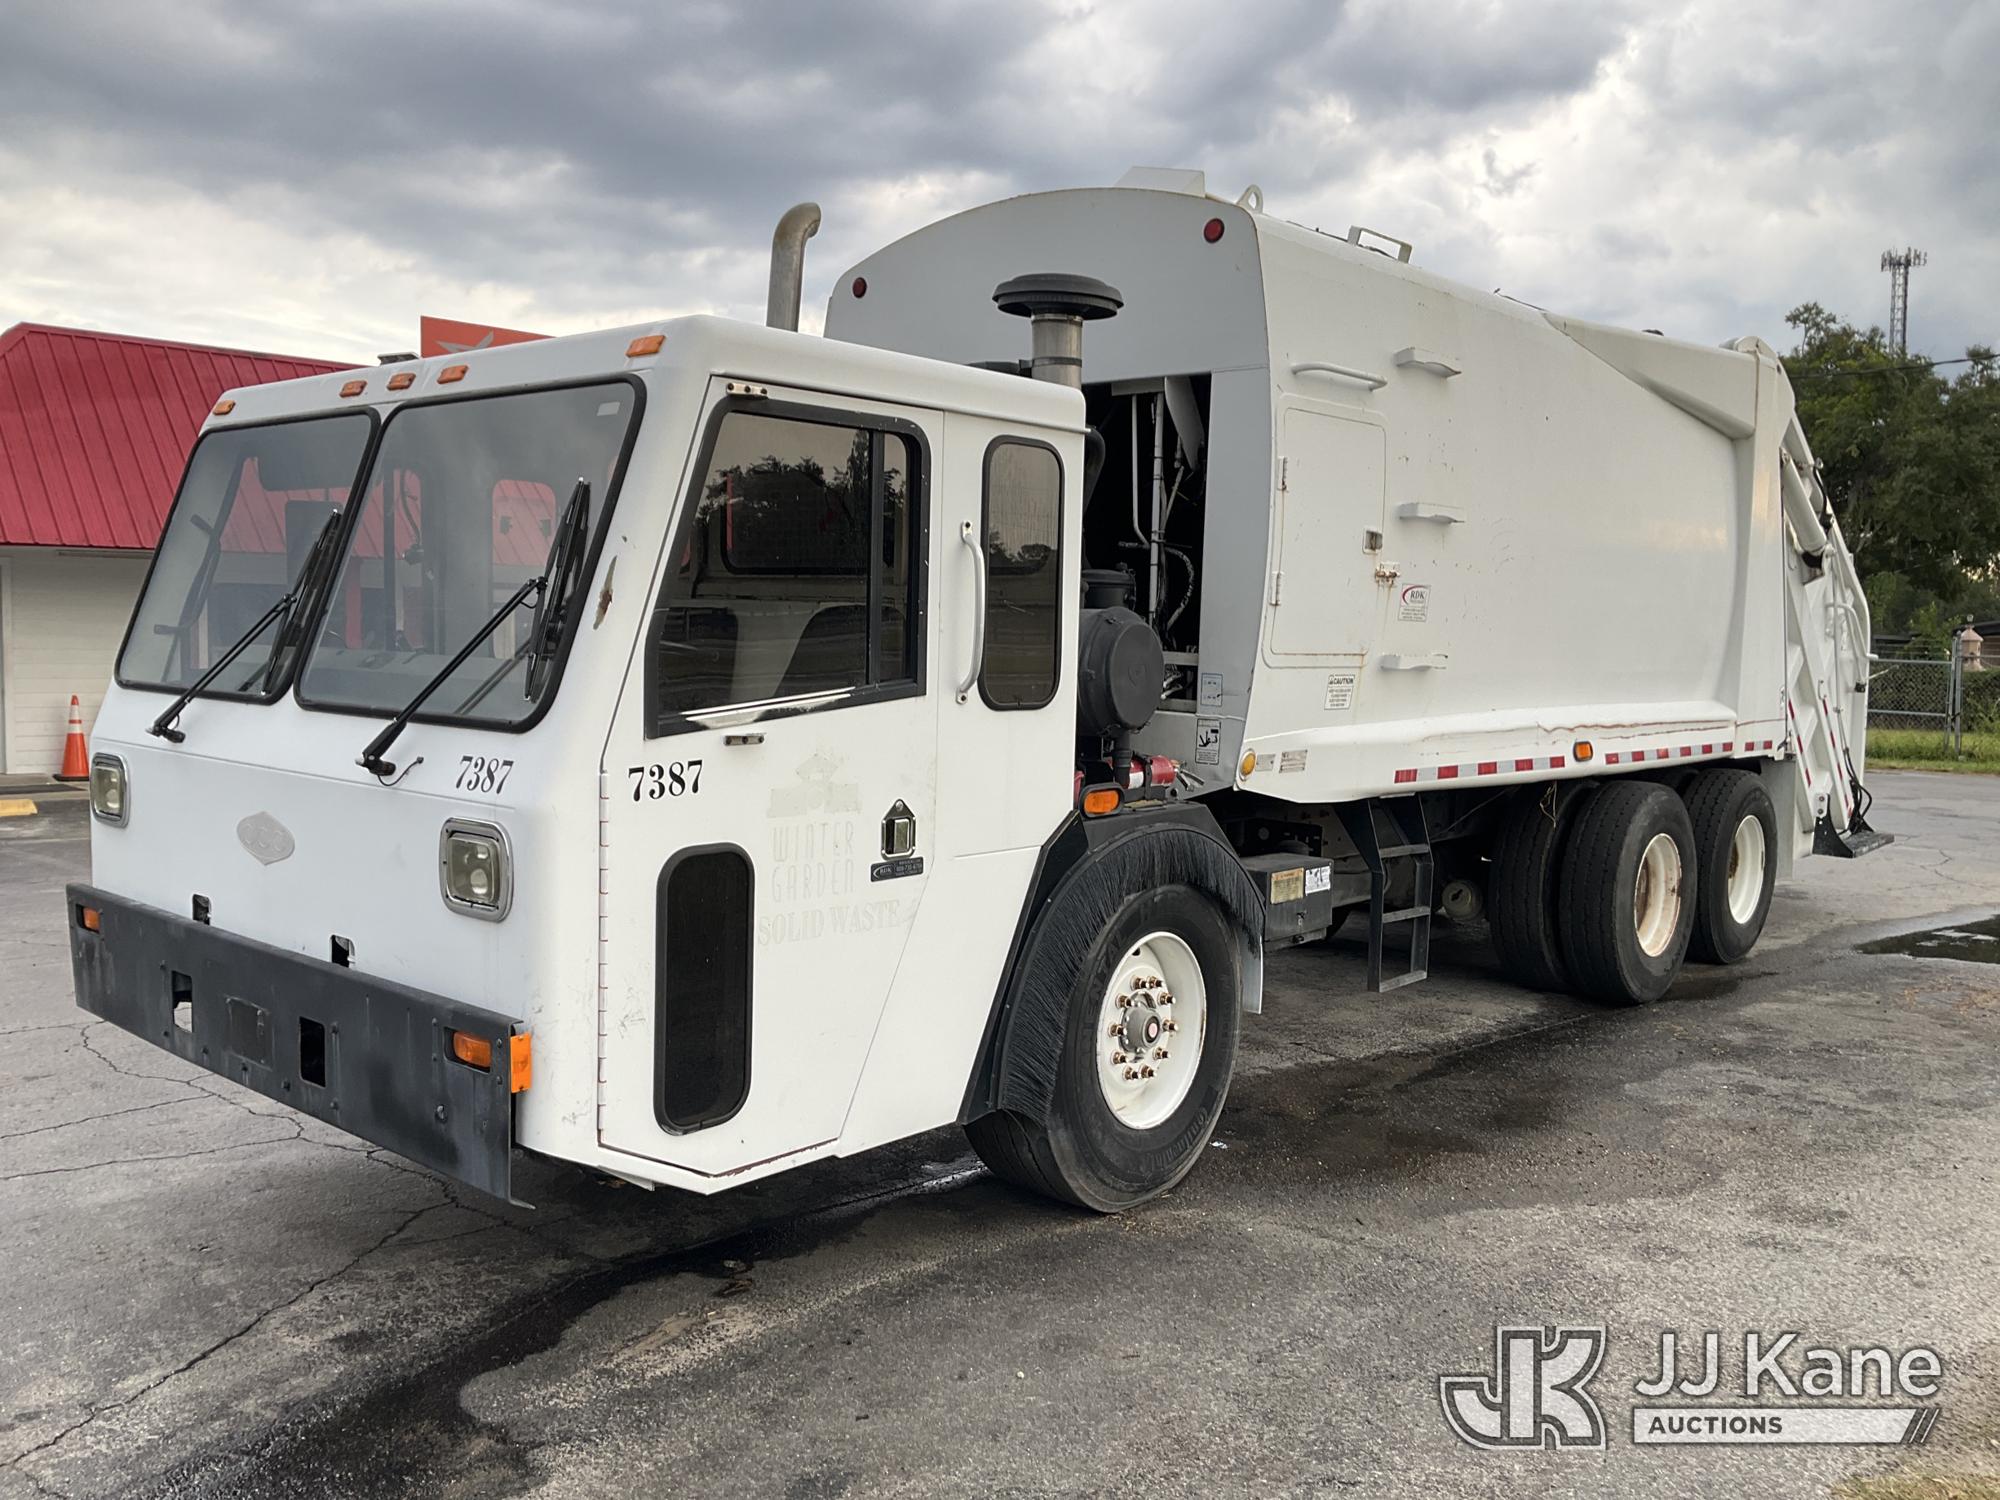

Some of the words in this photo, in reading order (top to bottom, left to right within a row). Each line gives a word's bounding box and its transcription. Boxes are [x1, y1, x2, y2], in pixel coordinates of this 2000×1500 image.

[1334, 677, 1354, 685] CAUTION
[455, 755, 515, 795] 7387
[627, 759, 704, 802] 7387
[772, 821, 856, 863] WINTER
[771, 859, 855, 903] GARDEN
[758, 909, 825, 946] SOLID
[830, 899, 901, 934] WASTE
